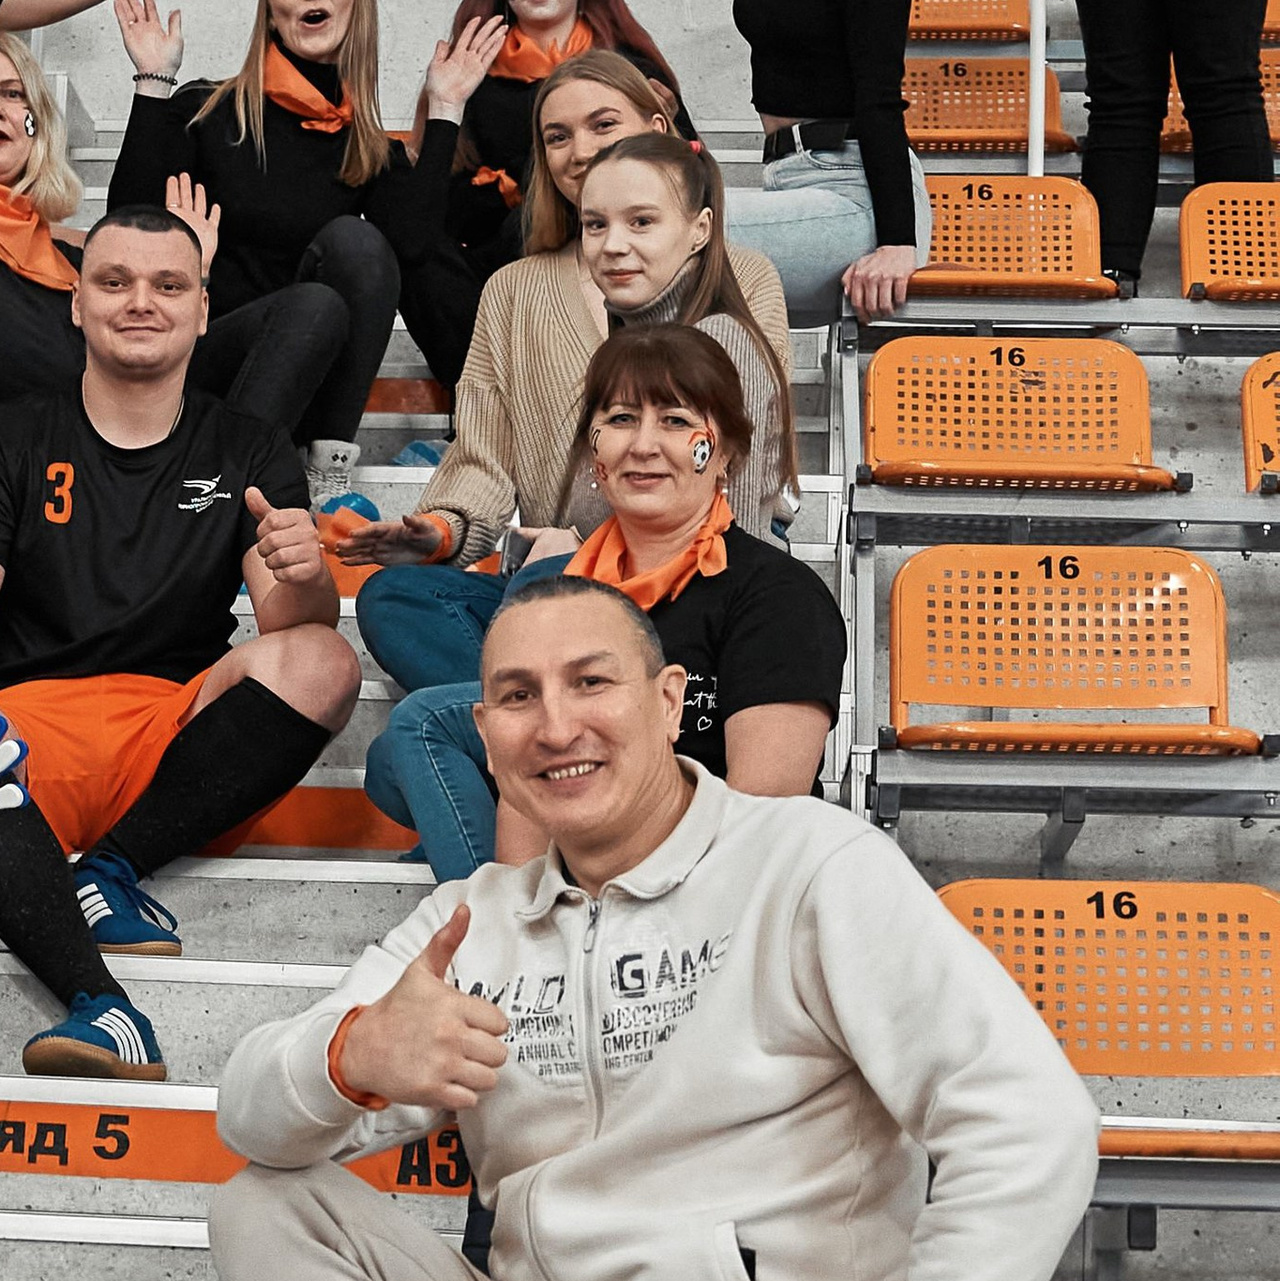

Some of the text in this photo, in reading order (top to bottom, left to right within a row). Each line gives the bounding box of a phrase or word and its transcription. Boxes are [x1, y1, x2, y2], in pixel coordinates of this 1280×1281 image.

[938, 62, 969, 78] 16
[961, 183, 994, 201] 16
[988, 346, 1027, 368] 16
[44, 461, 75, 525] 3
[1036, 554, 1081, 581] 16
[1085, 890, 1139, 921] 16
[93, 1113, 131, 1161] 5
